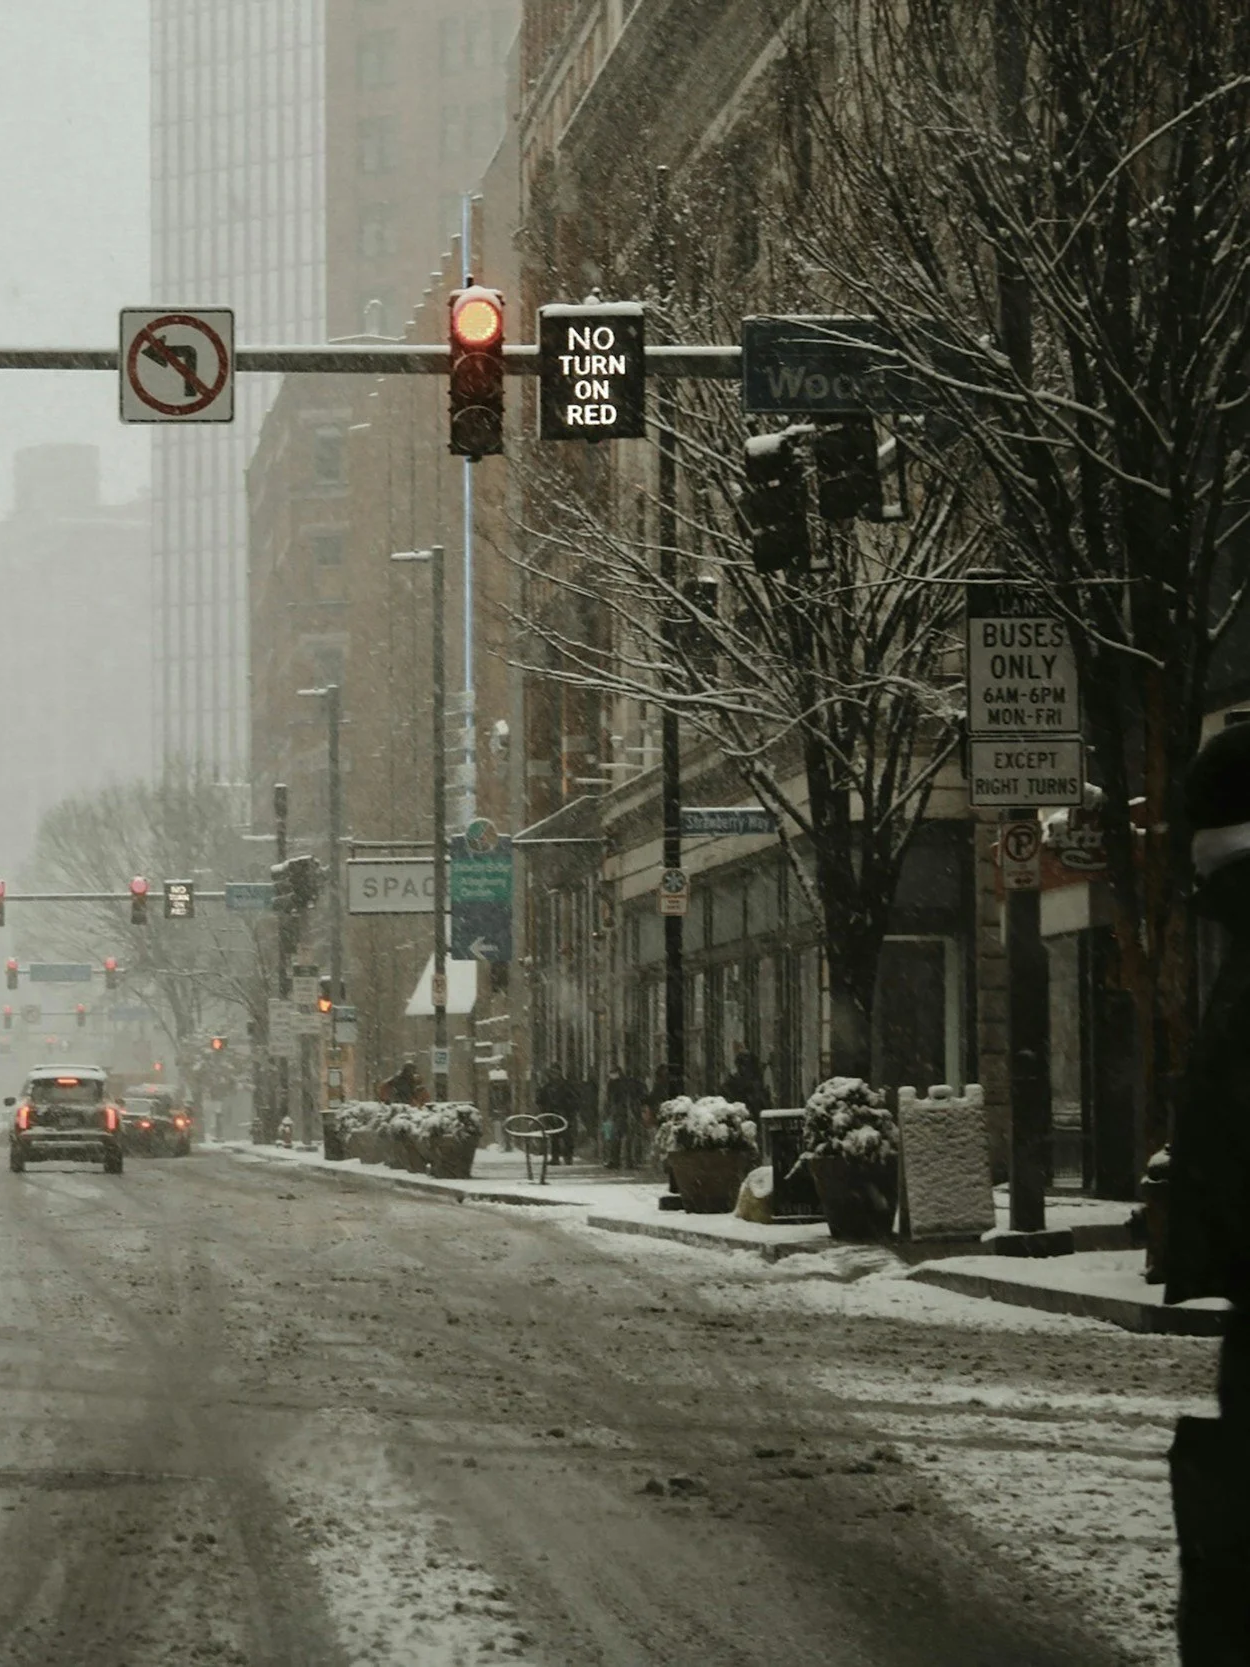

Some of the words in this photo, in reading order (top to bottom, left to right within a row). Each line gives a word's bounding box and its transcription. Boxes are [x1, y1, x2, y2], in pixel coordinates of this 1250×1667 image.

[568, 326, 615, 351] NO
[559, 354, 626, 376] TURN
[574, 379, 610, 400] ON
[566, 404, 617, 426] RED
[983, 622, 1064, 648] BUSES
[990, 654, 1058, 680] ONLY
[983, 686, 1066, 704] 6AM-6PM
[988, 708, 1063, 725] MON-FRI
[994, 751, 1058, 769] EXCEPT
[975, 778, 1019, 795] RIGHT
[1026, 778, 1078, 795] TURNS
[362, 876, 439, 898] SPAC
